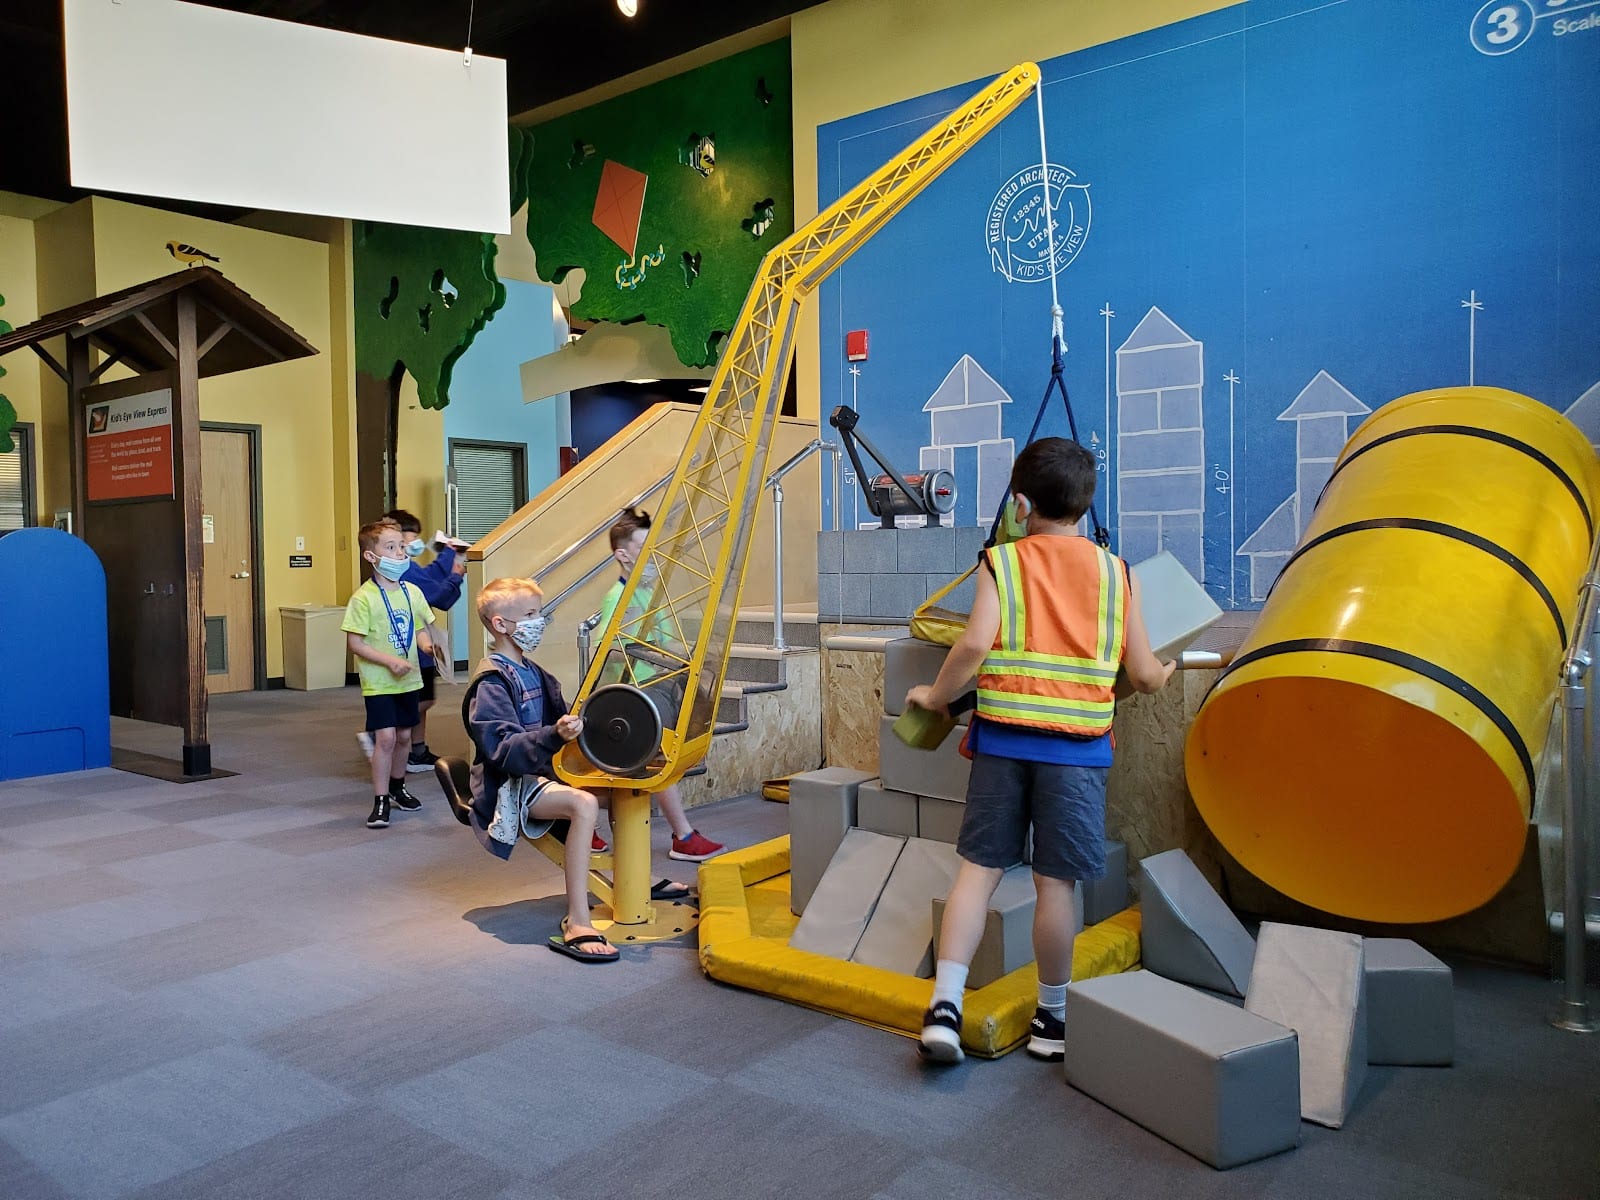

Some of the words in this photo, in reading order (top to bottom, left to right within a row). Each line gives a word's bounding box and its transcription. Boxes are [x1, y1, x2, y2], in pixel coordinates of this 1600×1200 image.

[1486, 7, 1519, 44] 3
[990, 182, 1019, 243] REGISTERED
[1019, 168, 1071, 186] ARCHTECT
[1012, 194, 1042, 223] 12345
[1027, 218, 1060, 249] UTAH
[1038, 240, 1060, 258] MAH
[1016, 264, 1045, 277] KID'S
[1064, 224, 1084, 255] VIEW
[110, 413, 122, 423] Kid's
[123, 411, 132, 422] Eye
[133, 409, 146, 419] View
[147, 406, 168, 418] Express
[1215, 463, 1231, 494] 40"
